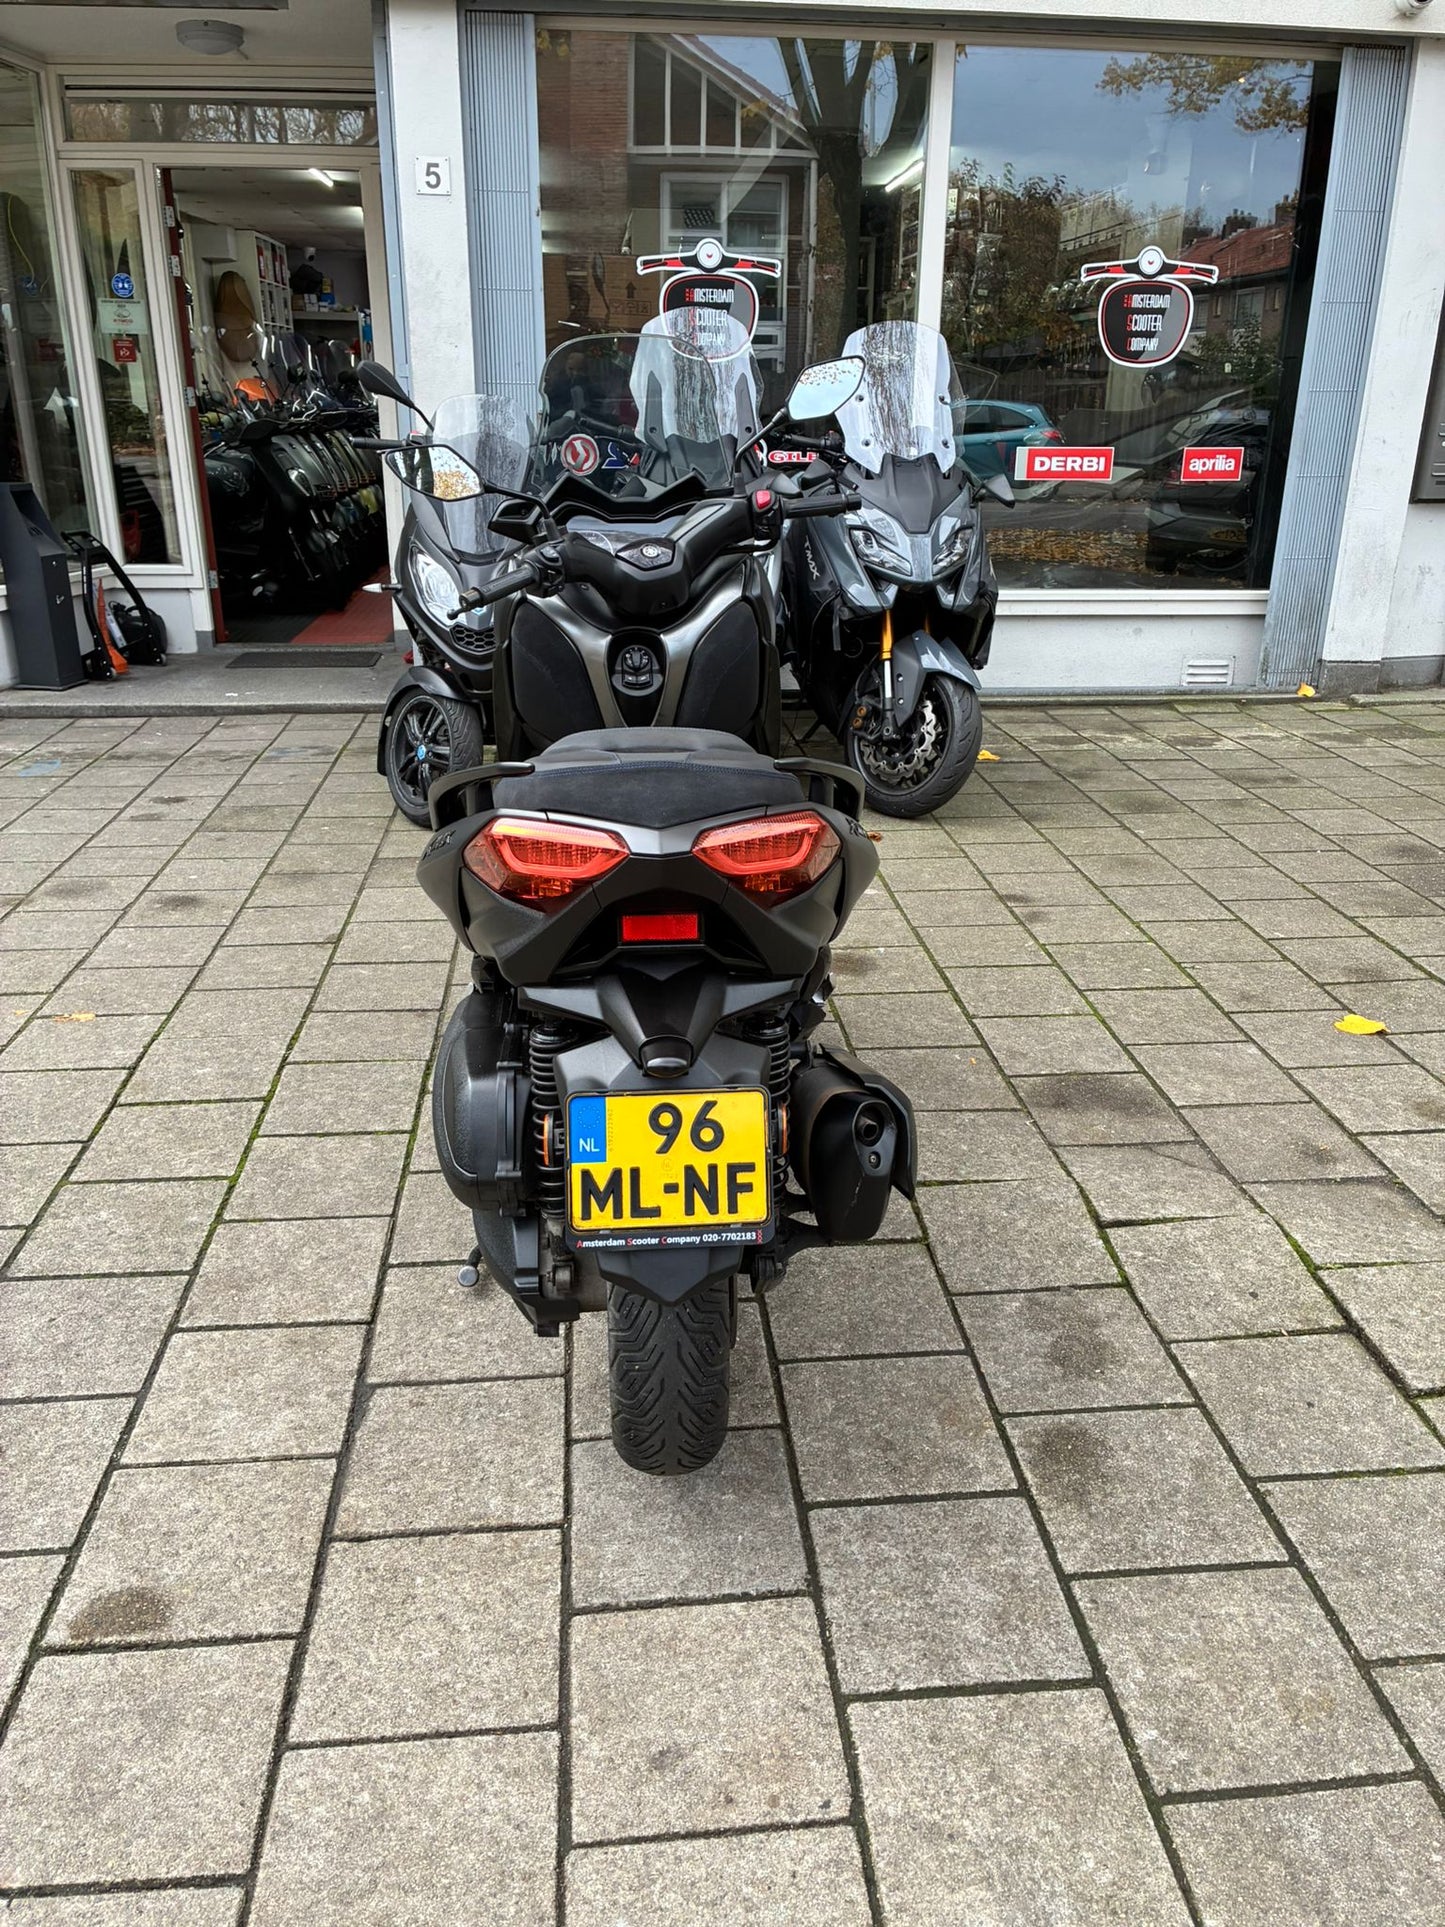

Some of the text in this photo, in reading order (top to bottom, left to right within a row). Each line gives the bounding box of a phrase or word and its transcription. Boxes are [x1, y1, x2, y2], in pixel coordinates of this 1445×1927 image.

[425, 162, 441, 189] 5
[689, 288, 735, 303] AMSTERDAM
[1127, 294, 1171, 309] AMSTERDAM
[689, 308, 728, 327] SCOOTER
[1126, 314, 1163, 332] SCOOTER
[1126, 337, 1159, 352] COMPANY
[1033, 456, 1106, 472] DERBI
[1189, 454, 1235, 474] aprilia
[804, 534, 821, 581] TMAX
[648, 1099, 725, 1154] 96
[579, 1137, 600, 1153] NL
[580, 1161, 756, 1221] ML-NF
[576, 1231, 757, 1248] Amsterdam Scooter Company 020-7702183
